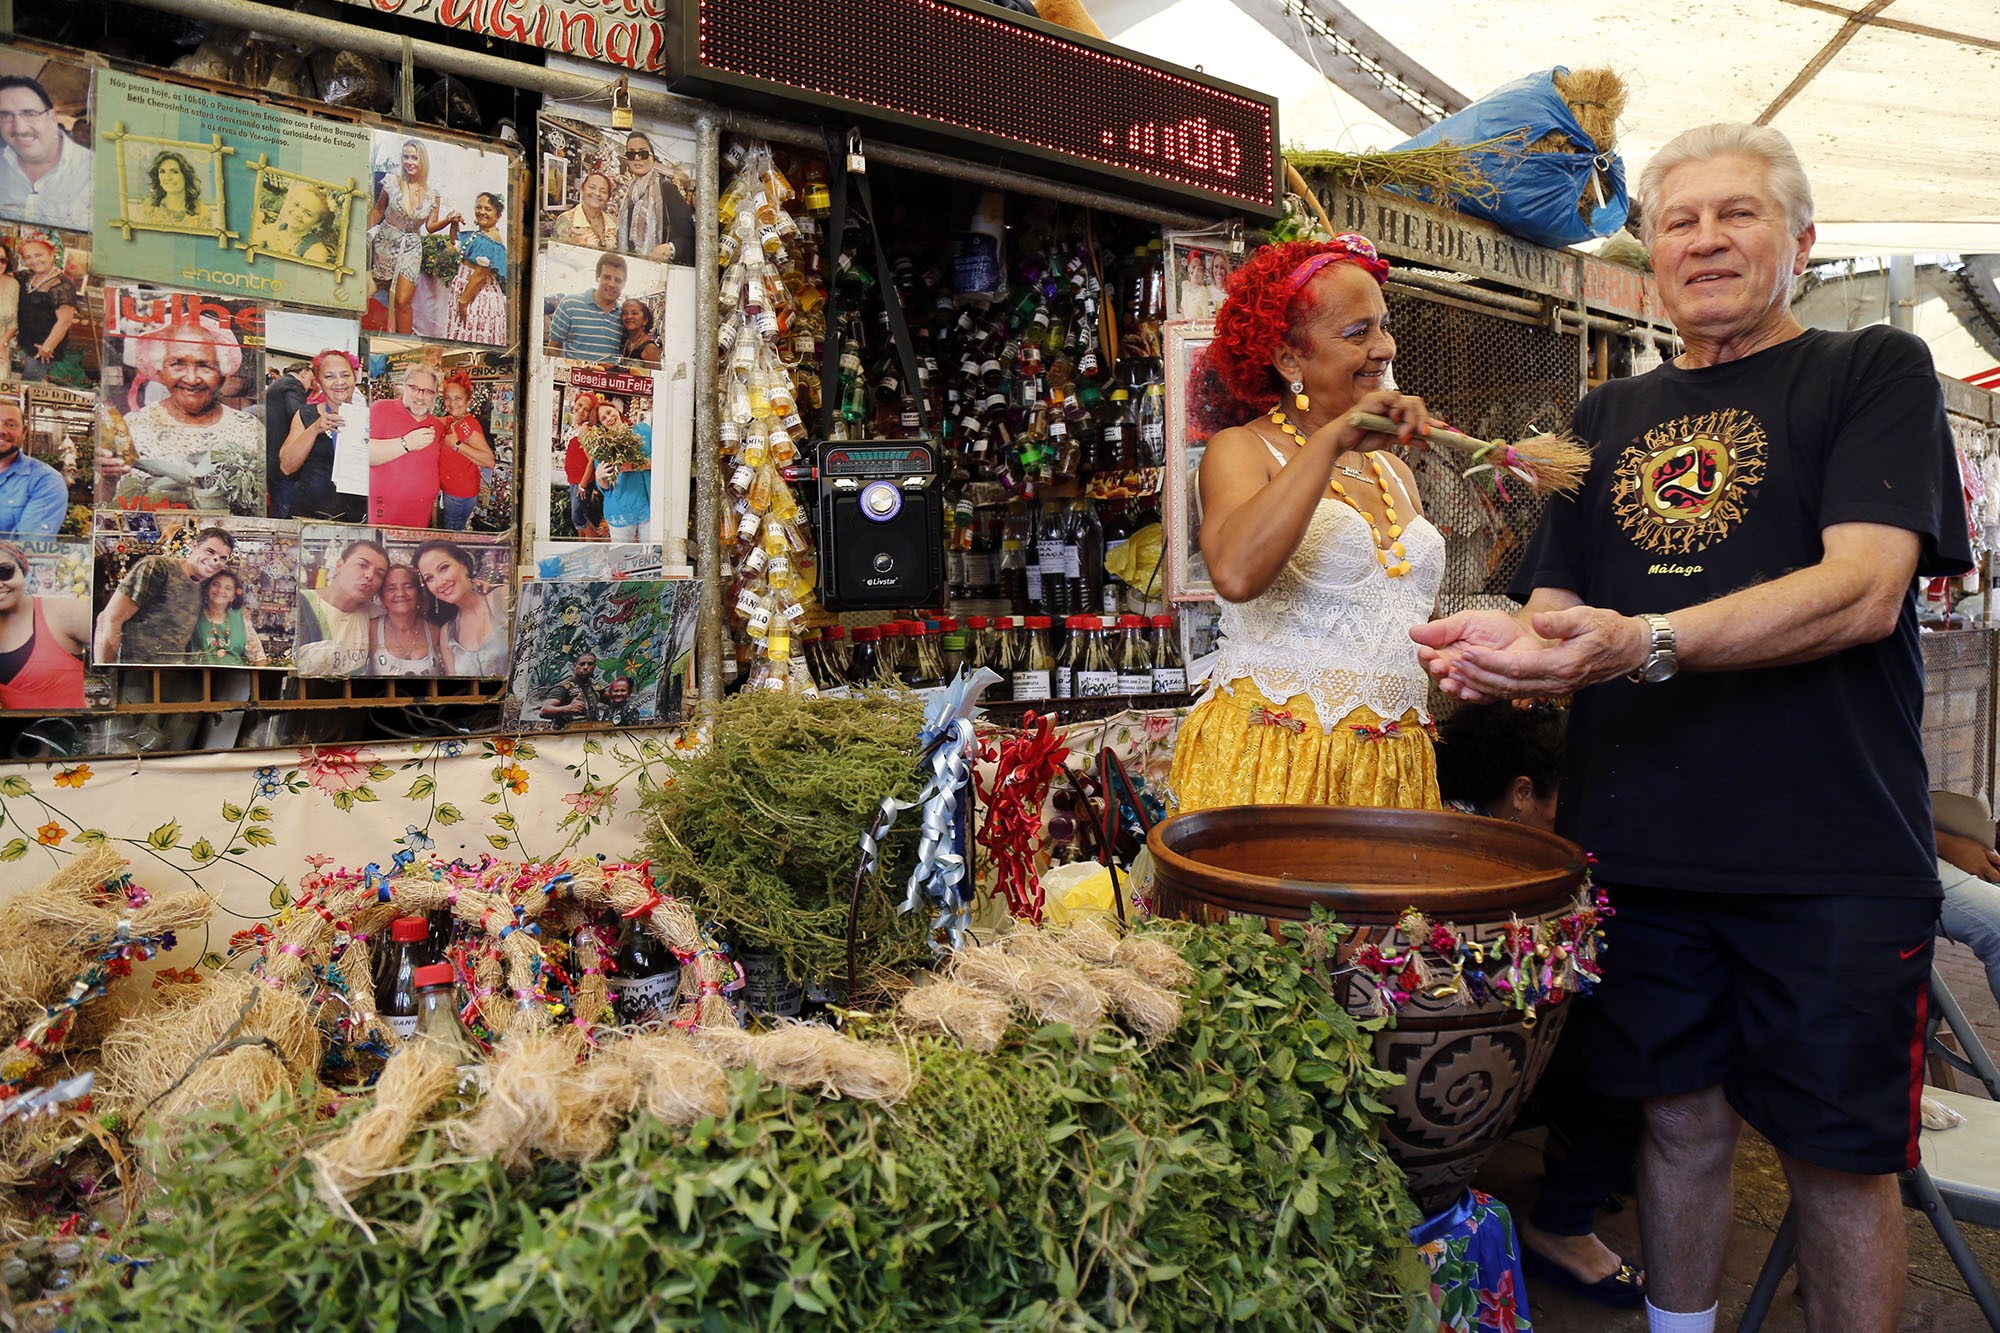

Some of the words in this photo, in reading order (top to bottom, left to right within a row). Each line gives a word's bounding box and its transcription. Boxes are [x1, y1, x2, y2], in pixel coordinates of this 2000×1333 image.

[128, 84, 150, 94] perca
[184, 94, 209, 108] 10h40,
[251, 110, 262, 119] um
[263, 112, 293, 126] Encontro
[294, 120, 309, 129] com
[127, 93, 145, 104] Beth
[216, 114, 260, 130] conversando
[261, 123, 281, 134] sobre
[282, 129, 322, 142] curiosidade
[323, 135, 332, 144] do
[333, 138, 356, 149] Estado
[238, 129, 248, 137] do
[182, 265, 284, 293] encontro
[573, 371, 607, 387] deseja
[608, 378, 625, 389] um
[627, 378, 653, 392] Feliz
[873, 577, 896, 586] Livstar
